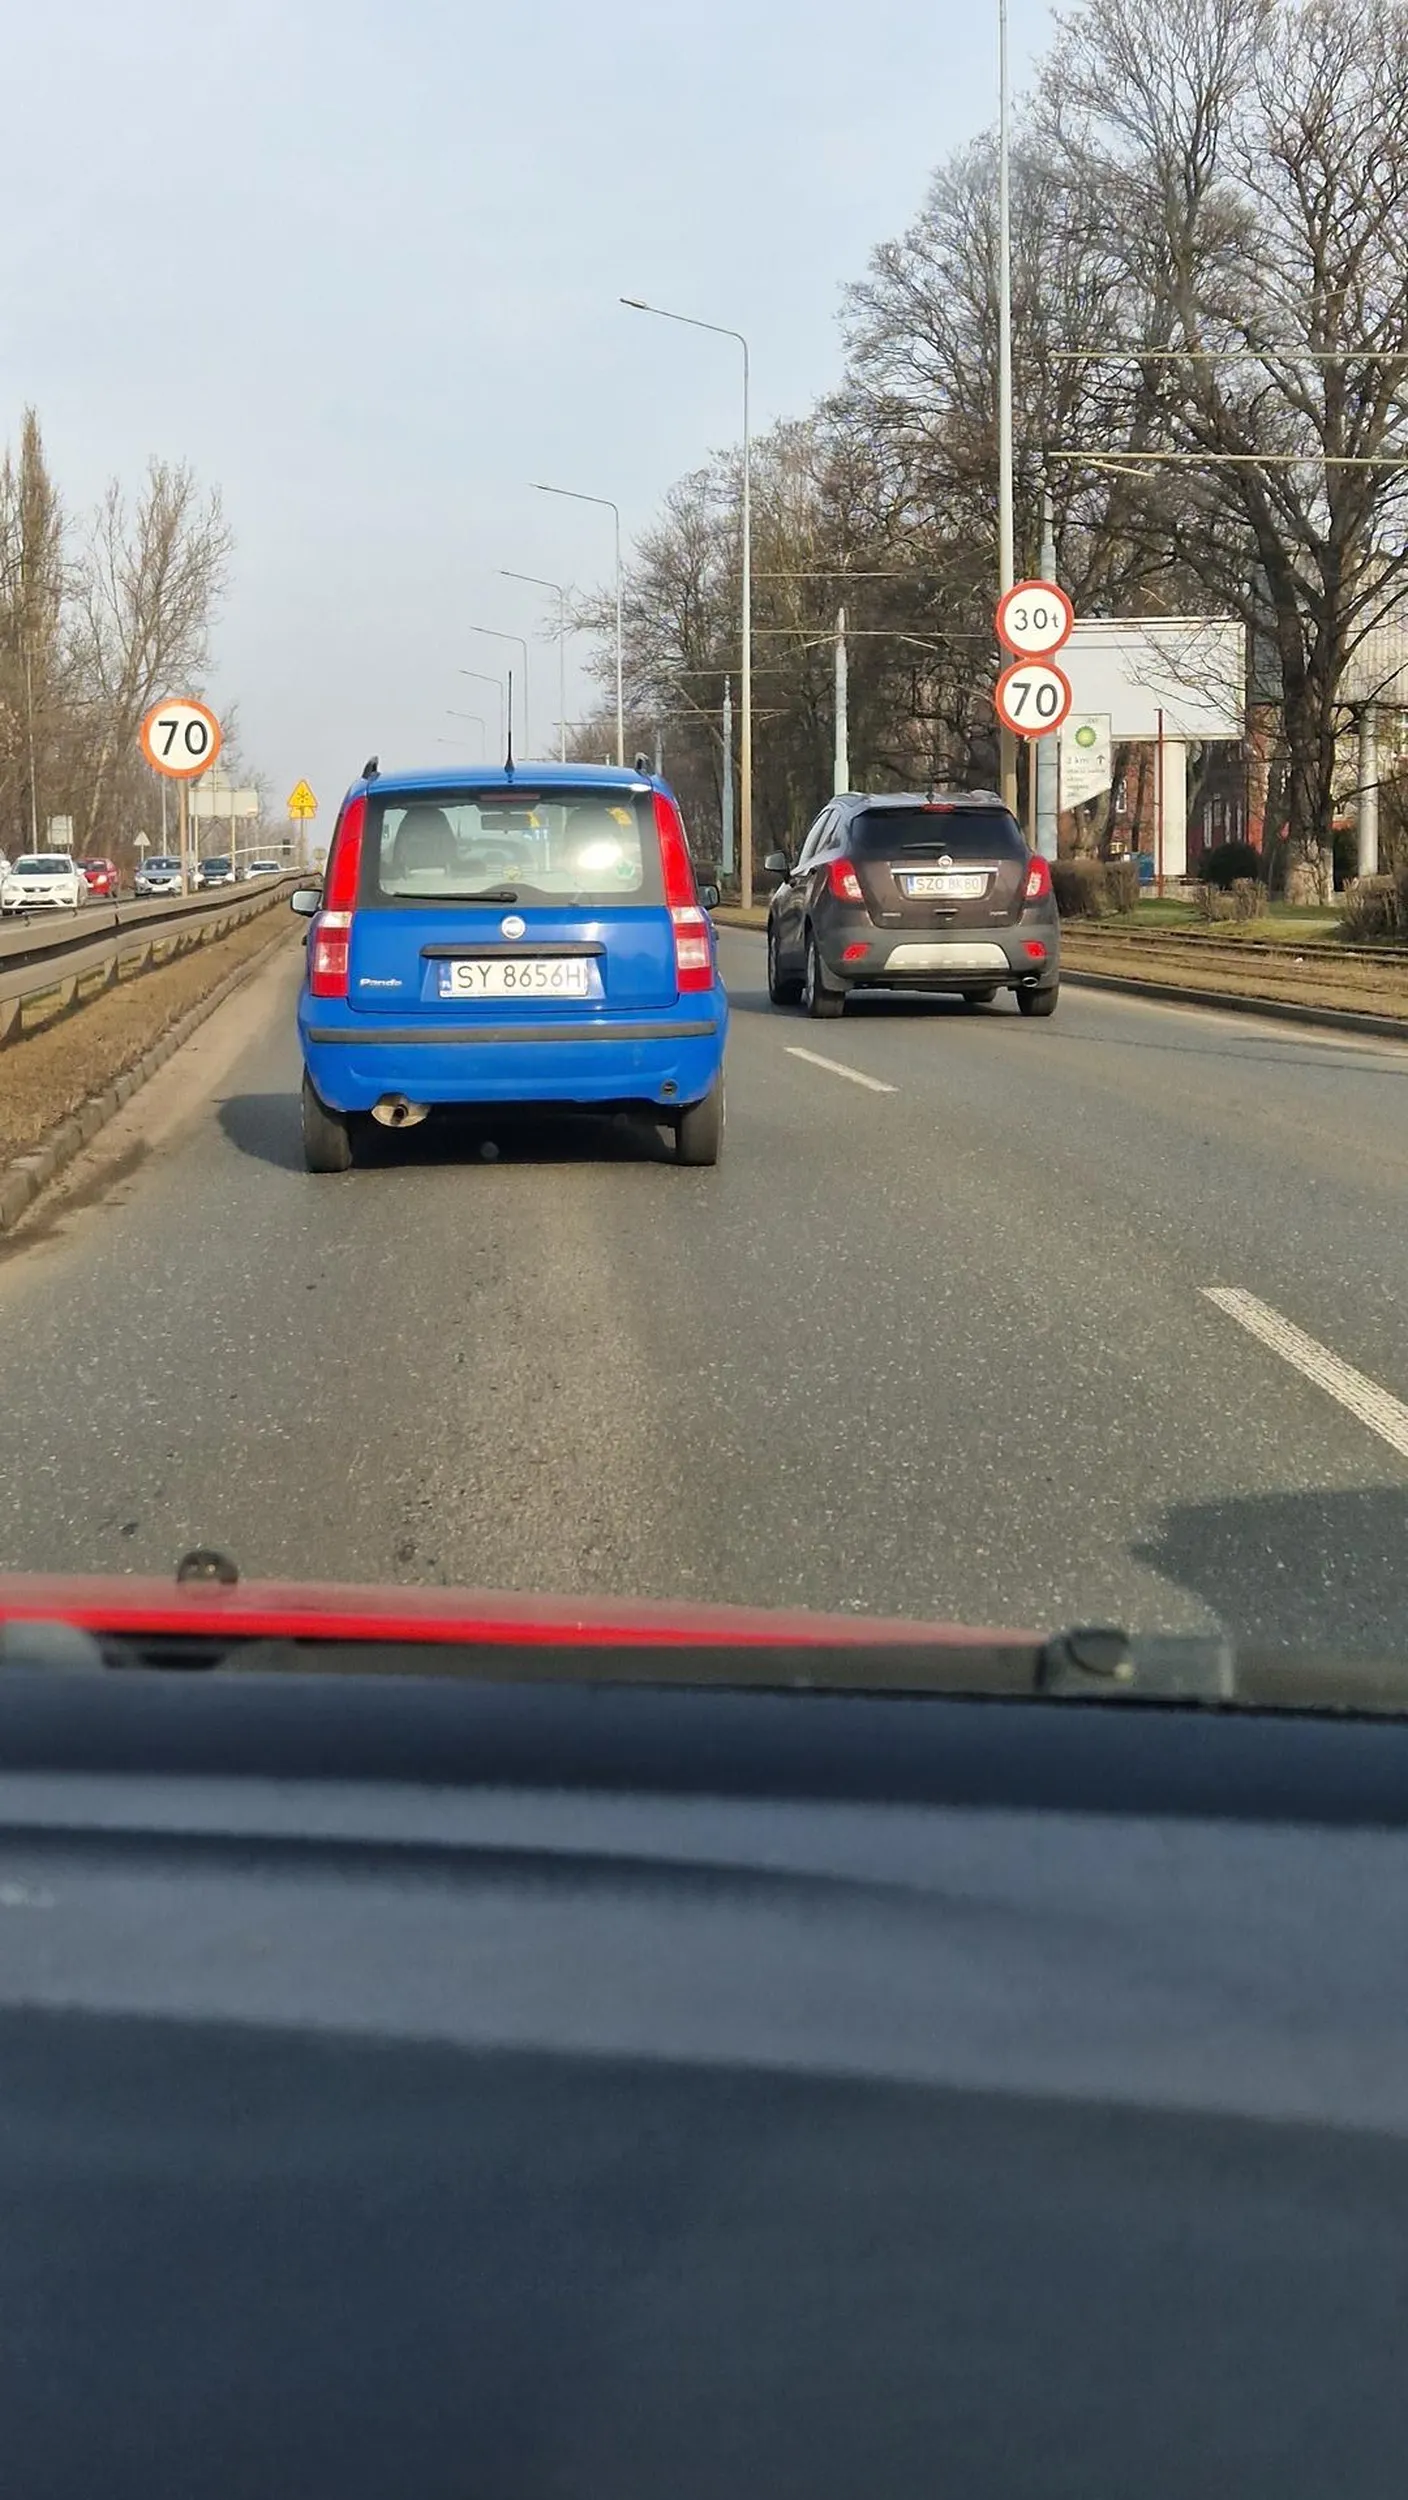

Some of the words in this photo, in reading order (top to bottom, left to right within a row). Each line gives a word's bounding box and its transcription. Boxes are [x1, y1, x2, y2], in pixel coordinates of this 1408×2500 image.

[1012, 682, 1058, 718] 70
[158, 720, 208, 756] 70
[457, 965, 492, 989] SY
[503, 964, 581, 988] 8656H
